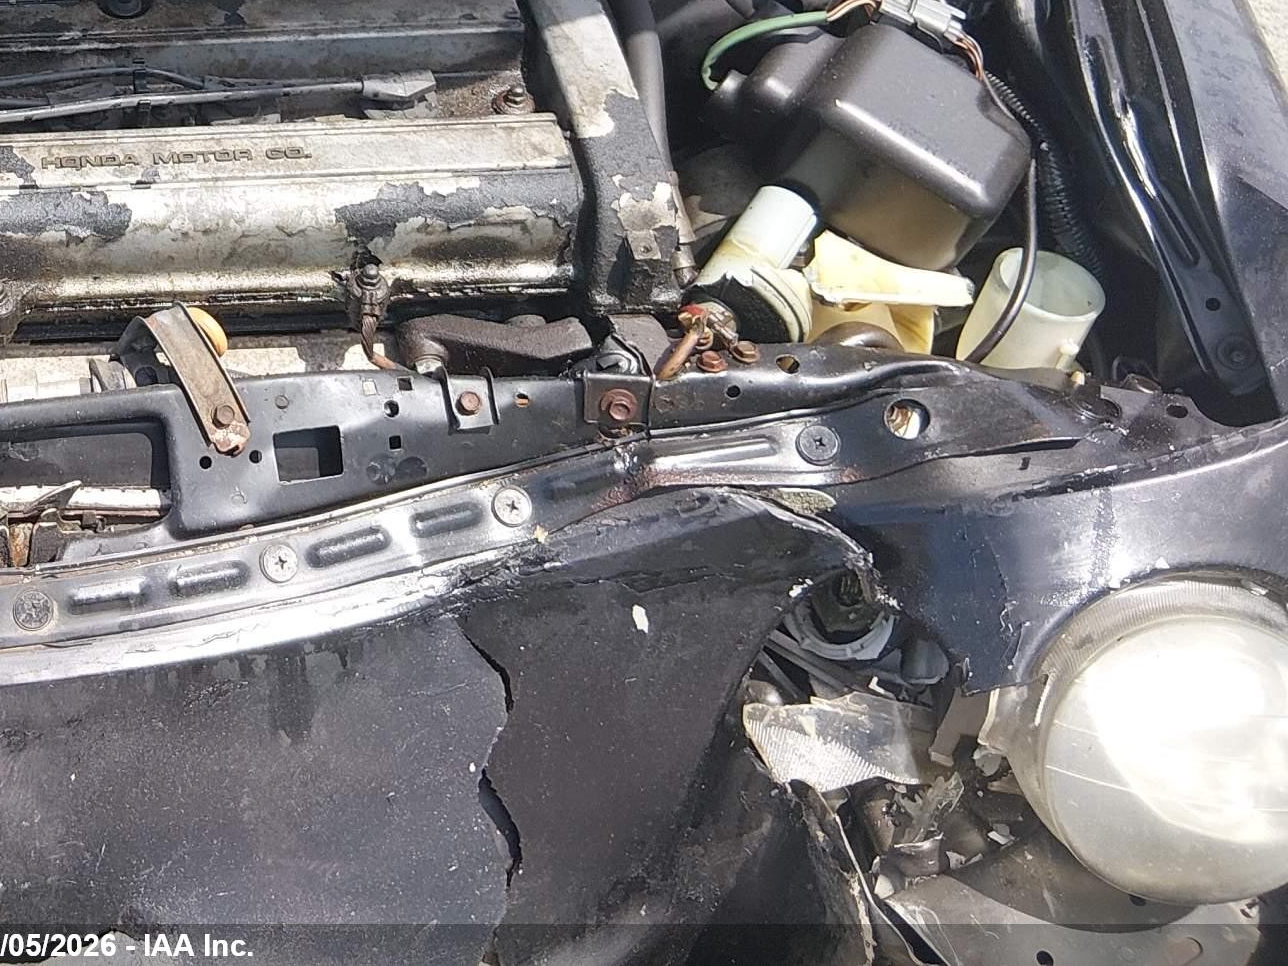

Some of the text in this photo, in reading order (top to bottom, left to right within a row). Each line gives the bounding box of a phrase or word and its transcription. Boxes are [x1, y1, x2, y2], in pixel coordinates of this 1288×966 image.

[41, 145, 312, 172] HONDA MOTOR CO.
